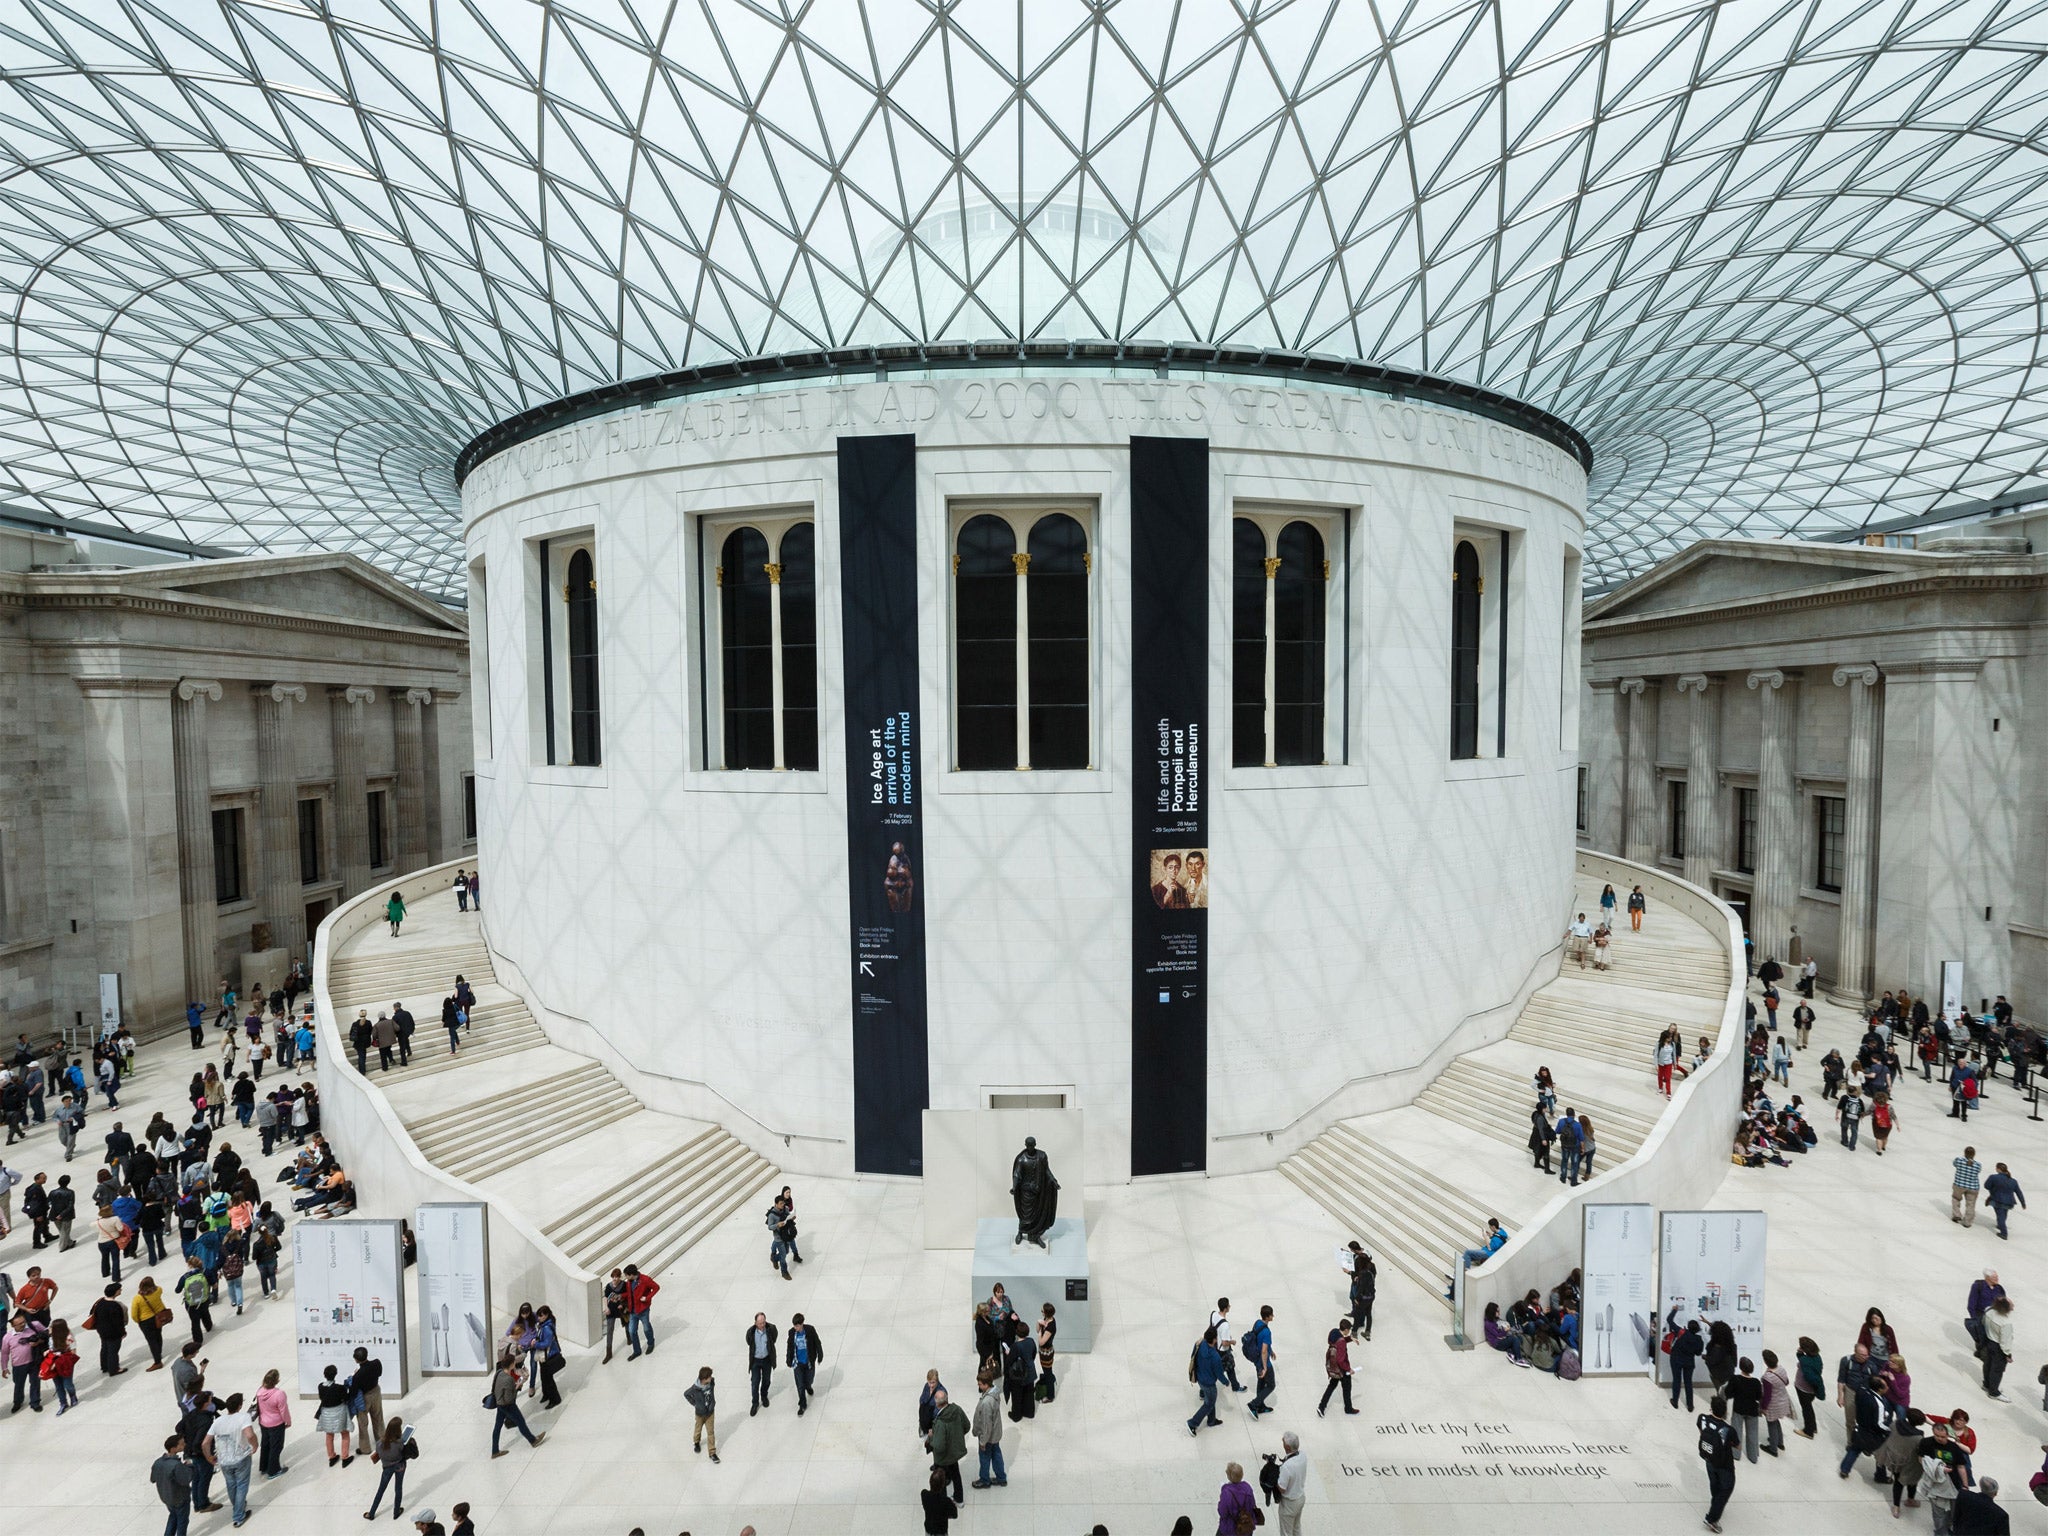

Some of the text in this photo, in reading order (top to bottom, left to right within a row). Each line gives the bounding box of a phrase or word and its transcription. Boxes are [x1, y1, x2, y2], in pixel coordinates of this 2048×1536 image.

[519, 426, 593, 480] QUEEN
[605, 393, 809, 455] ELIZABETH
[873, 385, 939, 423] AD
[965, 382, 1081, 420] 2000
[1102, 382, 1207, 422] THIS
[1228, 388, 1362, 434] GREAT
[1378, 403, 1477, 453] COURT
[870, 728, 884, 804] Ice Age art
[884, 717, 897, 804] arrival of the
[898, 712, 912, 804] modern mind
[1157, 718, 1169, 812] Life and death
[1172, 729, 1185, 812] Pompeii and
[1186, 723, 1198, 812] Herculaneum
[1588, 1211, 1596, 1230] Eating
[1376, 1422, 1512, 1437] and let thy feet
[1461, 1442, 1632, 1455] millenniums hence
[1342, 1463, 1611, 1480] be set in midst of knowledge
